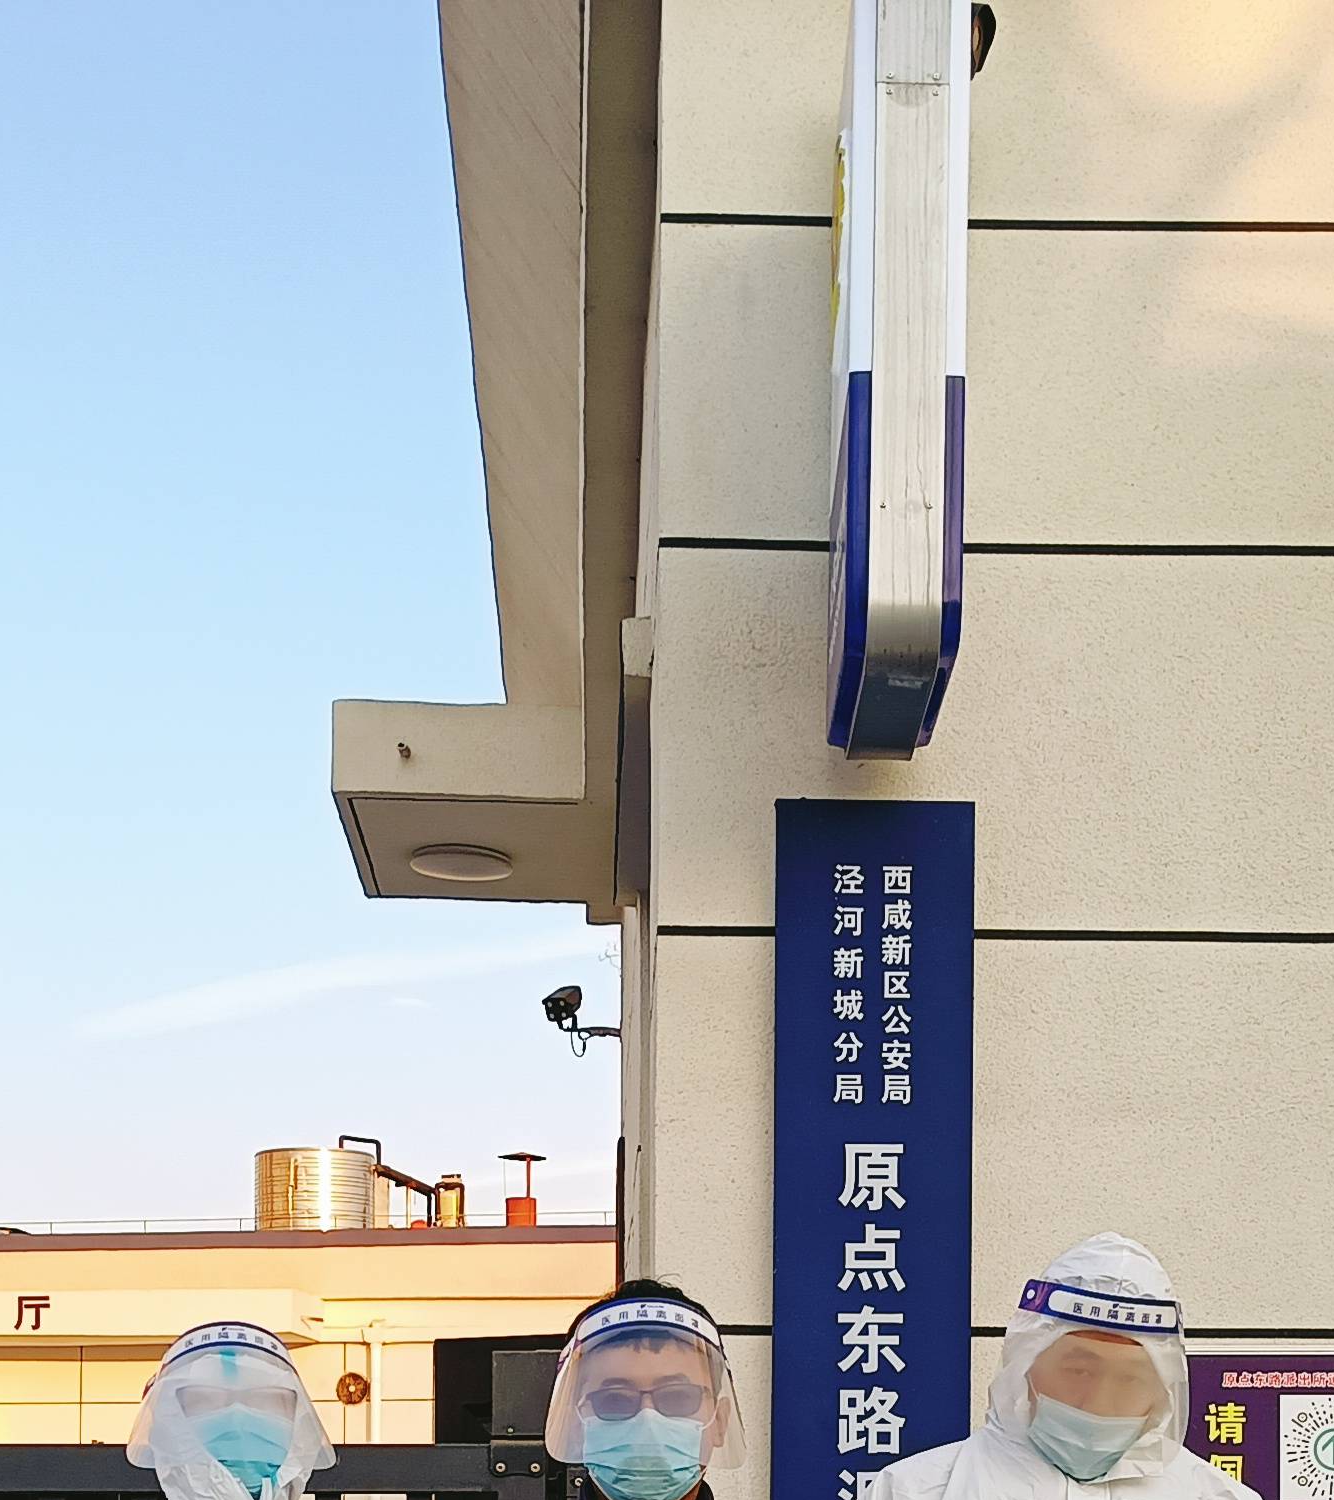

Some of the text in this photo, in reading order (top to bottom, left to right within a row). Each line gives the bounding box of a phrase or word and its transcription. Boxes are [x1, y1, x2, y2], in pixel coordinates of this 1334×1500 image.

[832, 864, 865, 1104] 泾河新城分局
[881, 864, 913, 1104] 西咸新区公安局
